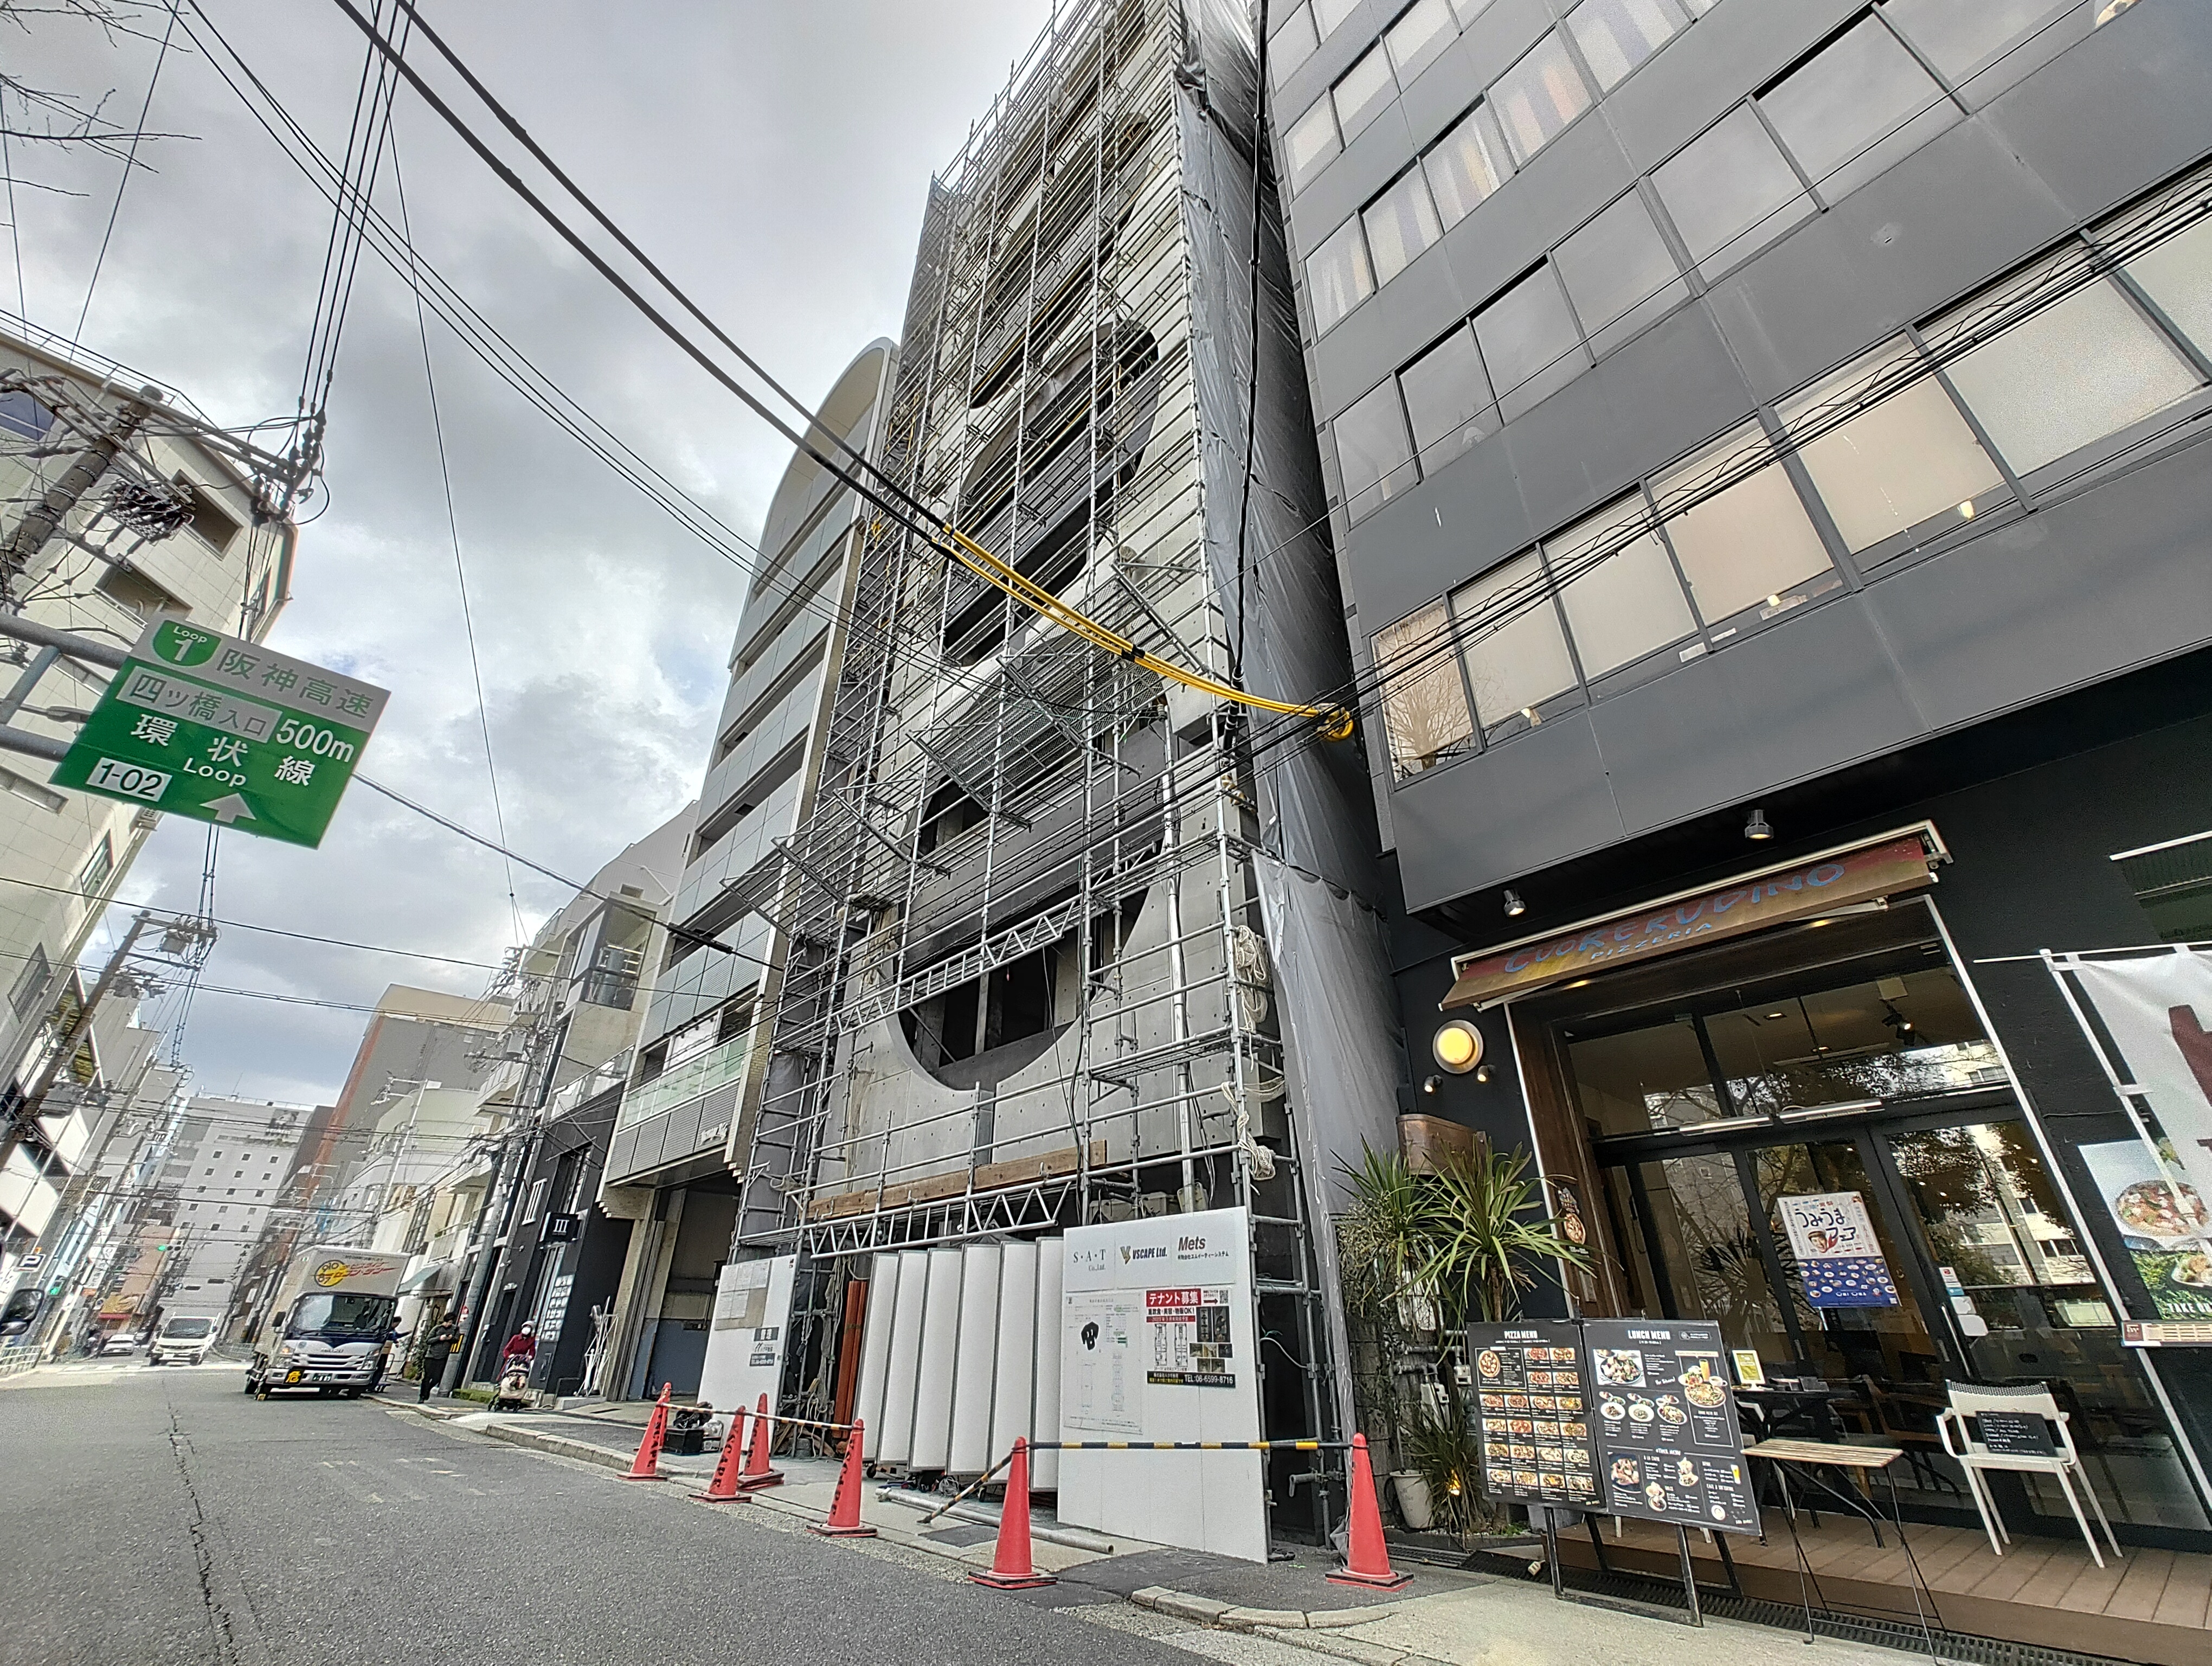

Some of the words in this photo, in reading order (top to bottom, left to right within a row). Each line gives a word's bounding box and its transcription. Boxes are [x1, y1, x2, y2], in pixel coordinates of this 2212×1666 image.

[173, 625, 208, 644] Loop
[174, 637, 192, 662] 1
[216, 648, 374, 719] 阪神高速
[128, 674, 267, 736] 四ツ橋入口
[275, 718, 355, 763] 500m
[99, 762, 163, 798] 1-02
[182, 757, 247, 788] Loop
[1591, 922, 1712, 960] PIZZERIA
[1795, 1207, 1844, 1228] うみうま
[1178, 1236, 1206, 1252] Mets
[20, 1255, 42, 1267] P
[1133, 1247, 1155, 1260] VSCAPE
[1156, 1247, 1167, 1258] Ltd.
[1149, 1291, 1199, 1305] テナント募集
[2166, 1303, 2196, 1313] TAKE
[2197, 1302, 2212, 1313] OU
[1504, 1330, 1521, 1339] PIZZA
[1521, 1330, 1538, 1339] MENU
[1628, 1330, 1650, 1339] LUNCH
[1650, 1331, 1671, 1340] MENU
[285, 1370, 301, 1383] 危
